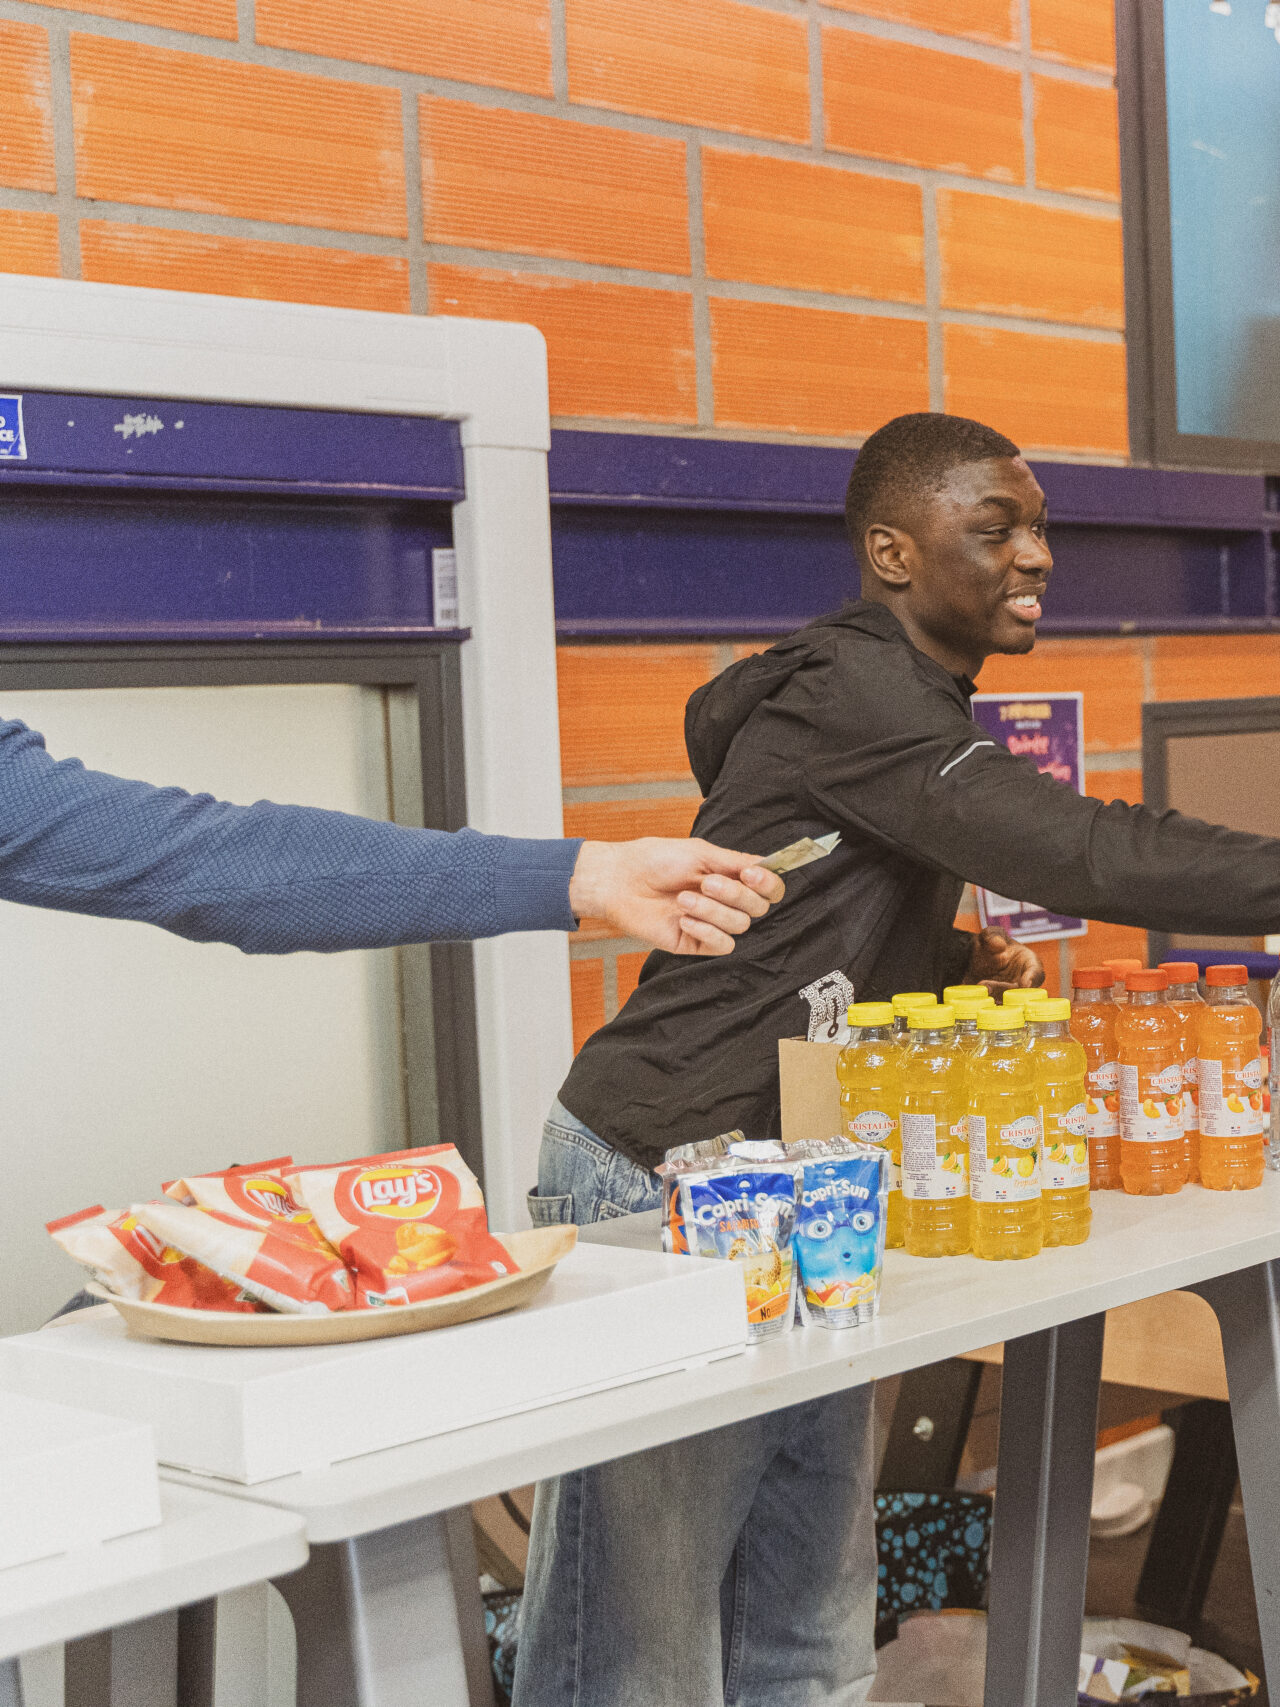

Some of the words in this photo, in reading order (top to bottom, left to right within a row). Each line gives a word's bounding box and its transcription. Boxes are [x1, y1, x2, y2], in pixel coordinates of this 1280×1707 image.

[1090, 1072, 1118, 1081] CRISTA
[847, 1120, 898, 1131] CRISTALINE
[360, 1171, 434, 1208] Lay's
[801, 1178, 870, 1208] Capri-Sun
[697, 1192, 794, 1227] Capri-Sn
